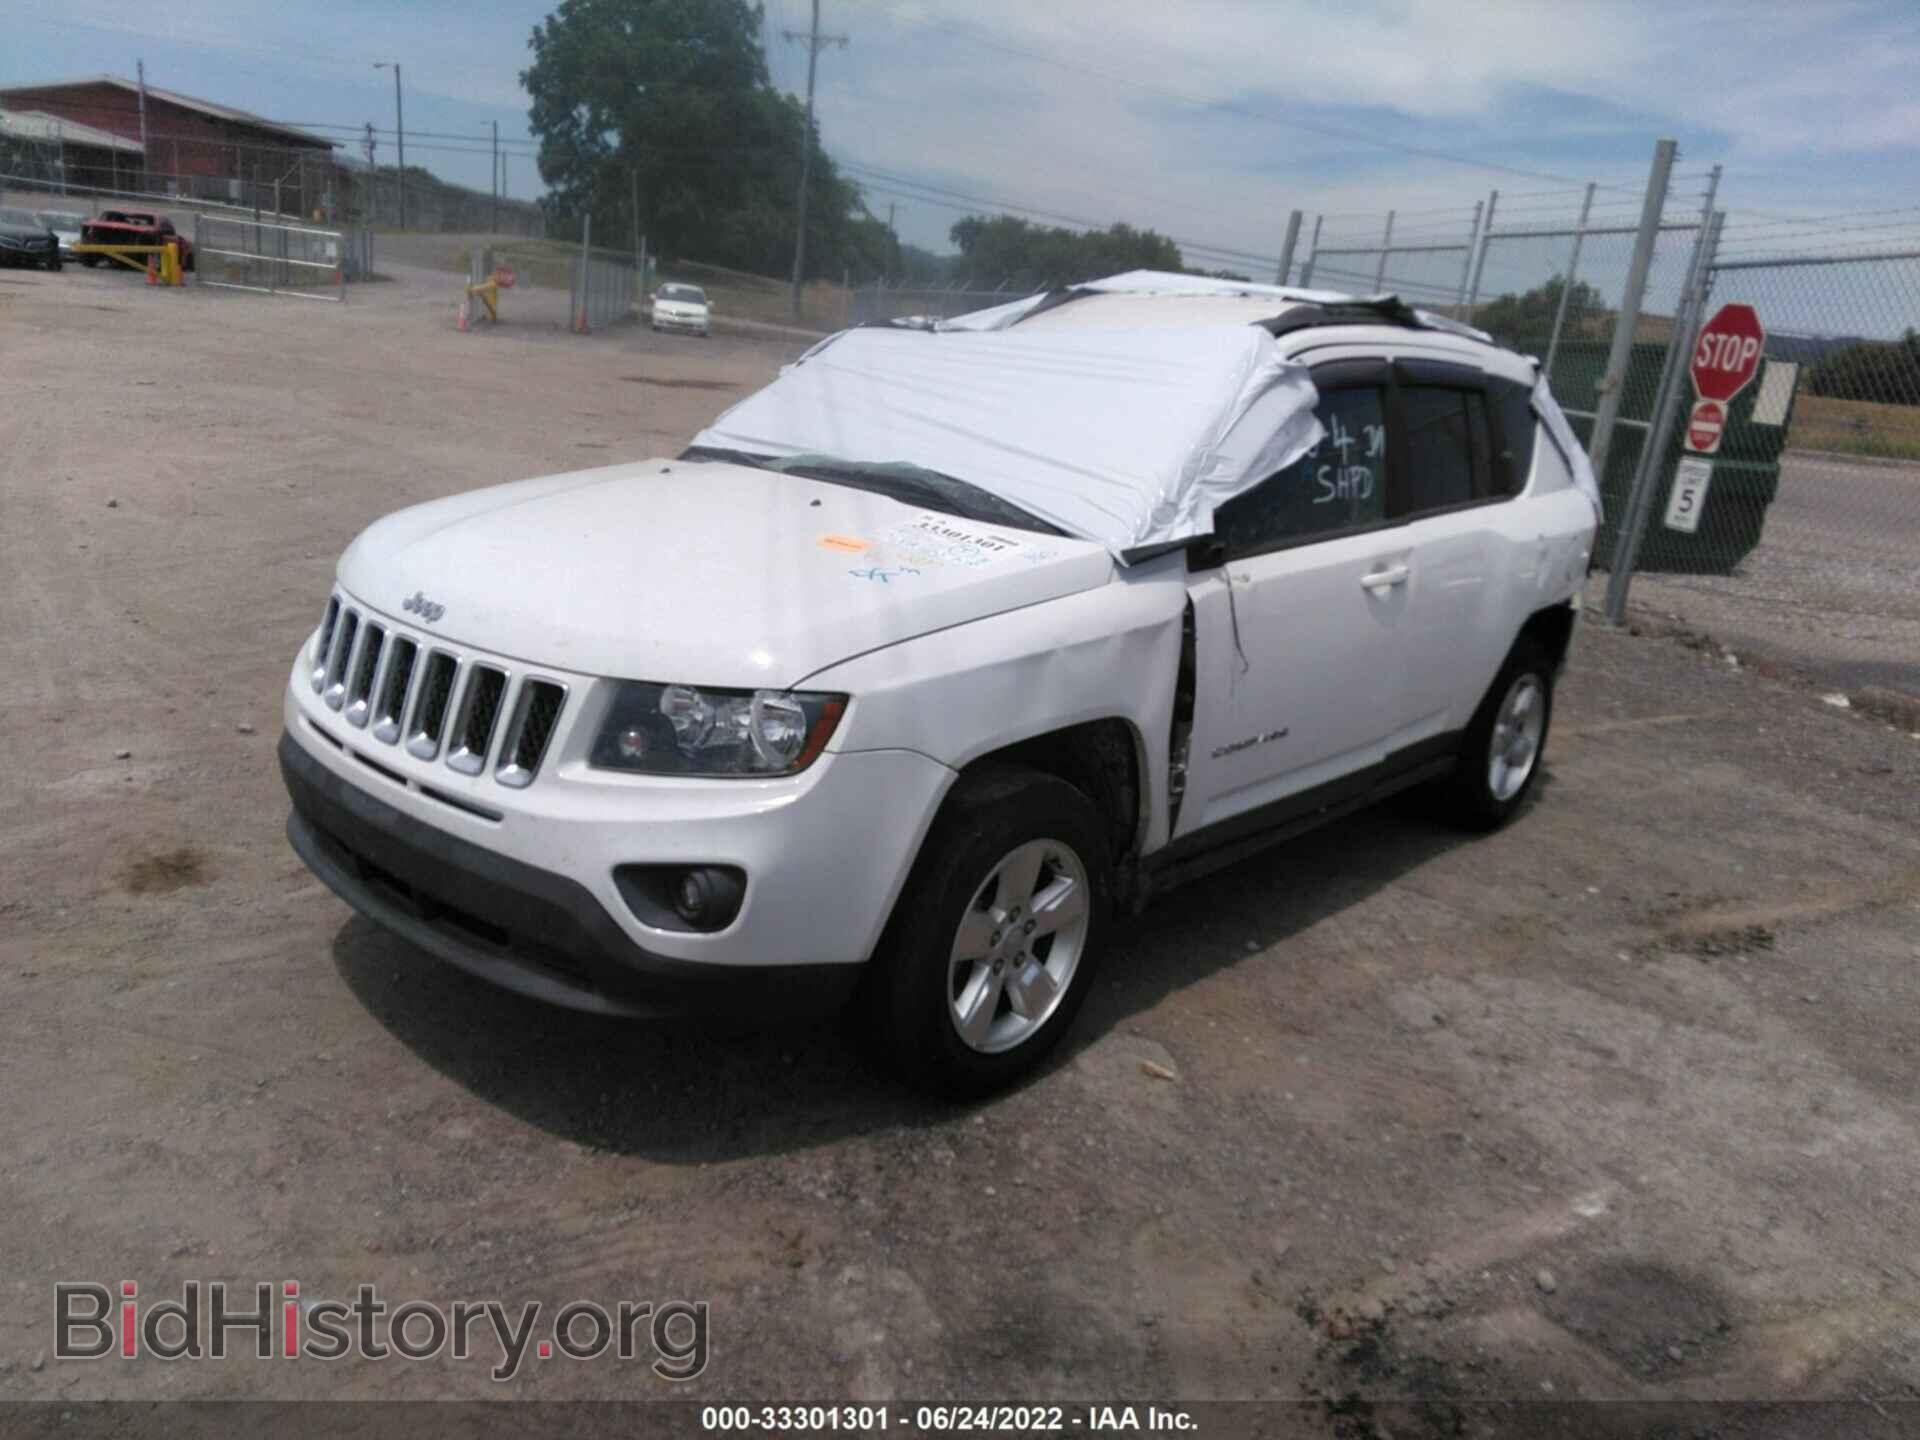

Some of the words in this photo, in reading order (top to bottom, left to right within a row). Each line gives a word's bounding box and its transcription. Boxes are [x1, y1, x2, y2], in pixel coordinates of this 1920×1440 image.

[1696, 332, 1759, 373] STOP
[1678, 488, 1696, 514] 5
[402, 590, 445, 624] Jeep
